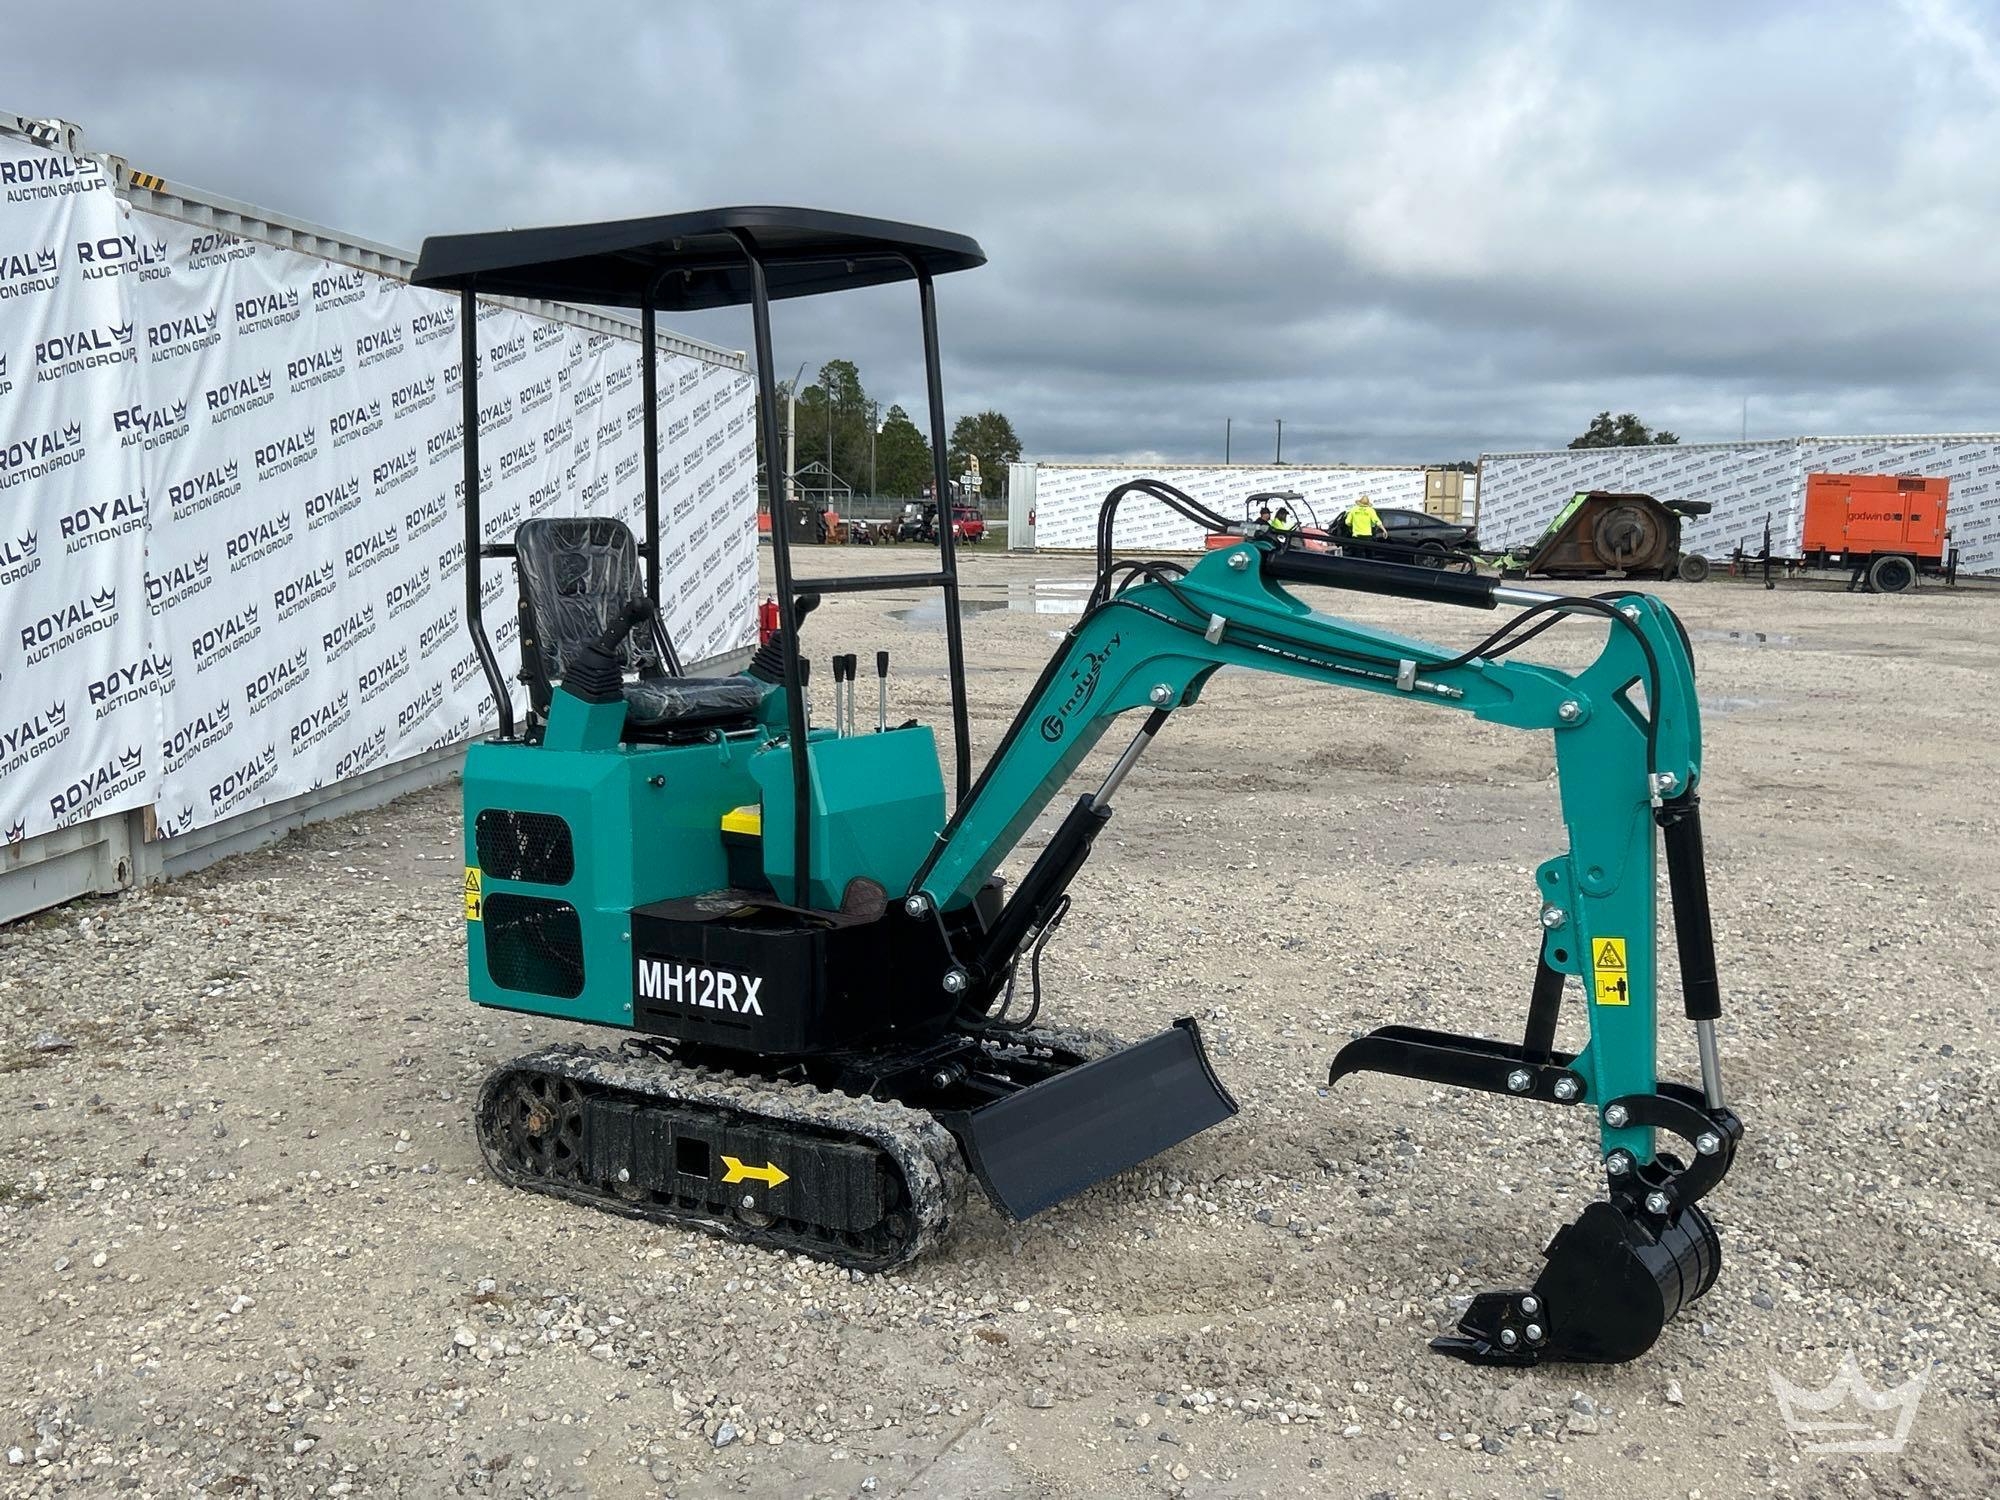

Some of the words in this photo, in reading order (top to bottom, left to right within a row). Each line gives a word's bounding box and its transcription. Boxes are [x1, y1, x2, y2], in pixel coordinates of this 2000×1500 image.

[1, 156, 75, 184] ROYAL
[7, 184, 57, 203] AUCTION
[59, 179, 107, 197] GROUP
[139, 267, 172, 282] GROUP
[188, 254, 227, 271] AUCTION
[228, 247, 255, 264] GROUP
[312, 274, 354, 300] ROYAL
[235, 293, 287, 321] ROYAL
[239, 321, 273, 336] AUCTION
[274, 310, 300, 325] GROUP
[412, 312, 447, 334] ROYAL
[35, 328, 111, 365] ROYAL
[149, 315, 206, 347] ROYAL
[356, 328, 393, 356] ROYAL
[533, 323, 558, 343] ROYAL
[151, 343, 192, 363] AUCTION
[193, 334, 221, 352] GROUP
[287, 350, 331, 380] ROYAL
[490, 337, 518, 362] ROYAL
[37, 359, 84, 383] AUCTION
[87, 348, 136, 368] GROUP
[290, 374, 322, 394] AUCTION
[323, 366, 345, 382] GROUP
[606, 370, 628, 387] ROYAL
[206, 376, 258, 410] ROYAL
[211, 402, 246, 425] AUCTION
[246, 393, 274, 411] GROUP
[391, 379, 427, 408] ROYAL
[520, 383, 545, 404] ROYAL
[574, 386, 595, 406] ROYAL
[159, 424, 190, 445] GROUP
[330, 408, 370, 435] ROYAL
[543, 423, 566, 445] ROYAL
[255, 432, 304, 468] ROYAL
[427, 429, 458, 454] ROYAL
[1910, 449, 1931, 457] ROYAL
[1959, 452, 1981, 461] ROYAL
[49, 448, 86, 470] GROUP
[258, 461, 292, 483] AUCTION
[293, 448, 318, 465] GROUP
[373, 453, 409, 485] ROYAL
[500, 447, 528, 470] ROYAL
[168, 467, 225, 507] ROYAL
[173, 497, 212, 522] AUCTION
[212, 482, 242, 504] GROUP
[304, 484, 349, 519] ROYAL
[529, 484, 556, 508] ROYAL
[60, 494, 144, 539] ROYAL
[308, 509, 339, 532] AUCTION
[338, 497, 361, 515] GROUP
[406, 500, 438, 531] ROYAL
[485, 508, 513, 537] ROYAL
[1848, 512, 1882, 521] godwin
[1964, 519, 1986, 527] ROYAL
[65, 527, 121, 556] AUCTION
[226, 520, 279, 560] ROYAL
[230, 547, 265, 574] AUCTION
[265, 533, 293, 555] GROUP
[345, 532, 386, 567] ROYAL
[1, 558, 41, 586] GROUP
[1966, 553, 1989, 561] ROYAL
[180, 576, 212, 602] GROUP
[274, 570, 322, 610] ROYAL
[278, 594, 309, 623] AUCTION
[310, 581, 337, 604] GROUP
[386, 574, 422, 608] ROYAL
[21, 600, 94, 650] ROYAL
[26, 630, 75, 668] AUCTION
[76, 612, 120, 640] GROUP
[192, 614, 245, 660] ROYAL
[323, 609, 364, 652] ROYAL
[420, 615, 450, 648] ROYAL
[421, 640, 443, 660] AUCTION
[442, 623, 459, 642] GROUP
[197, 641, 231, 674] AUCTION
[232, 626, 262, 652] GROUP
[326, 637, 354, 664] AUCTION
[353, 623, 376, 644] GROUP
[88, 654, 160, 704] ROYAL
[246, 662, 297, 702] ROYAL
[359, 655, 399, 693] ROYAL
[362, 680, 389, 704] AUCTION
[388, 665, 411, 686] GROUP
[1059, 632, 1121, 718] industry
[96, 686, 148, 720] AUCTION
[250, 689, 284, 717] AUCTION
[285, 669, 310, 692] GROUP
[398, 690, 431, 728] ROYAL
[290, 701, 338, 744] ROYAL
[292, 730, 327, 757] AUCTION
[327, 710, 351, 732] GROUP
[400, 712, 424, 738] AUCTION
[424, 698, 443, 717] GROUP
[30, 727, 70, 757] GROUP
[162, 712, 218, 758] ROYAL
[163, 744, 202, 775] AUCTION
[202, 722, 234, 750] GROUP
[336, 737, 375, 779] ROYAL
[365, 744, 386, 768] GROUP
[50, 760, 120, 819] ROYAL
[103, 770, 146, 801] GROUP
[209, 757, 265, 805] ROYAL
[214, 786, 251, 819] AUCTION
[252, 764, 278, 792] GROUP
[638, 959, 764, 1016] MH12RX
